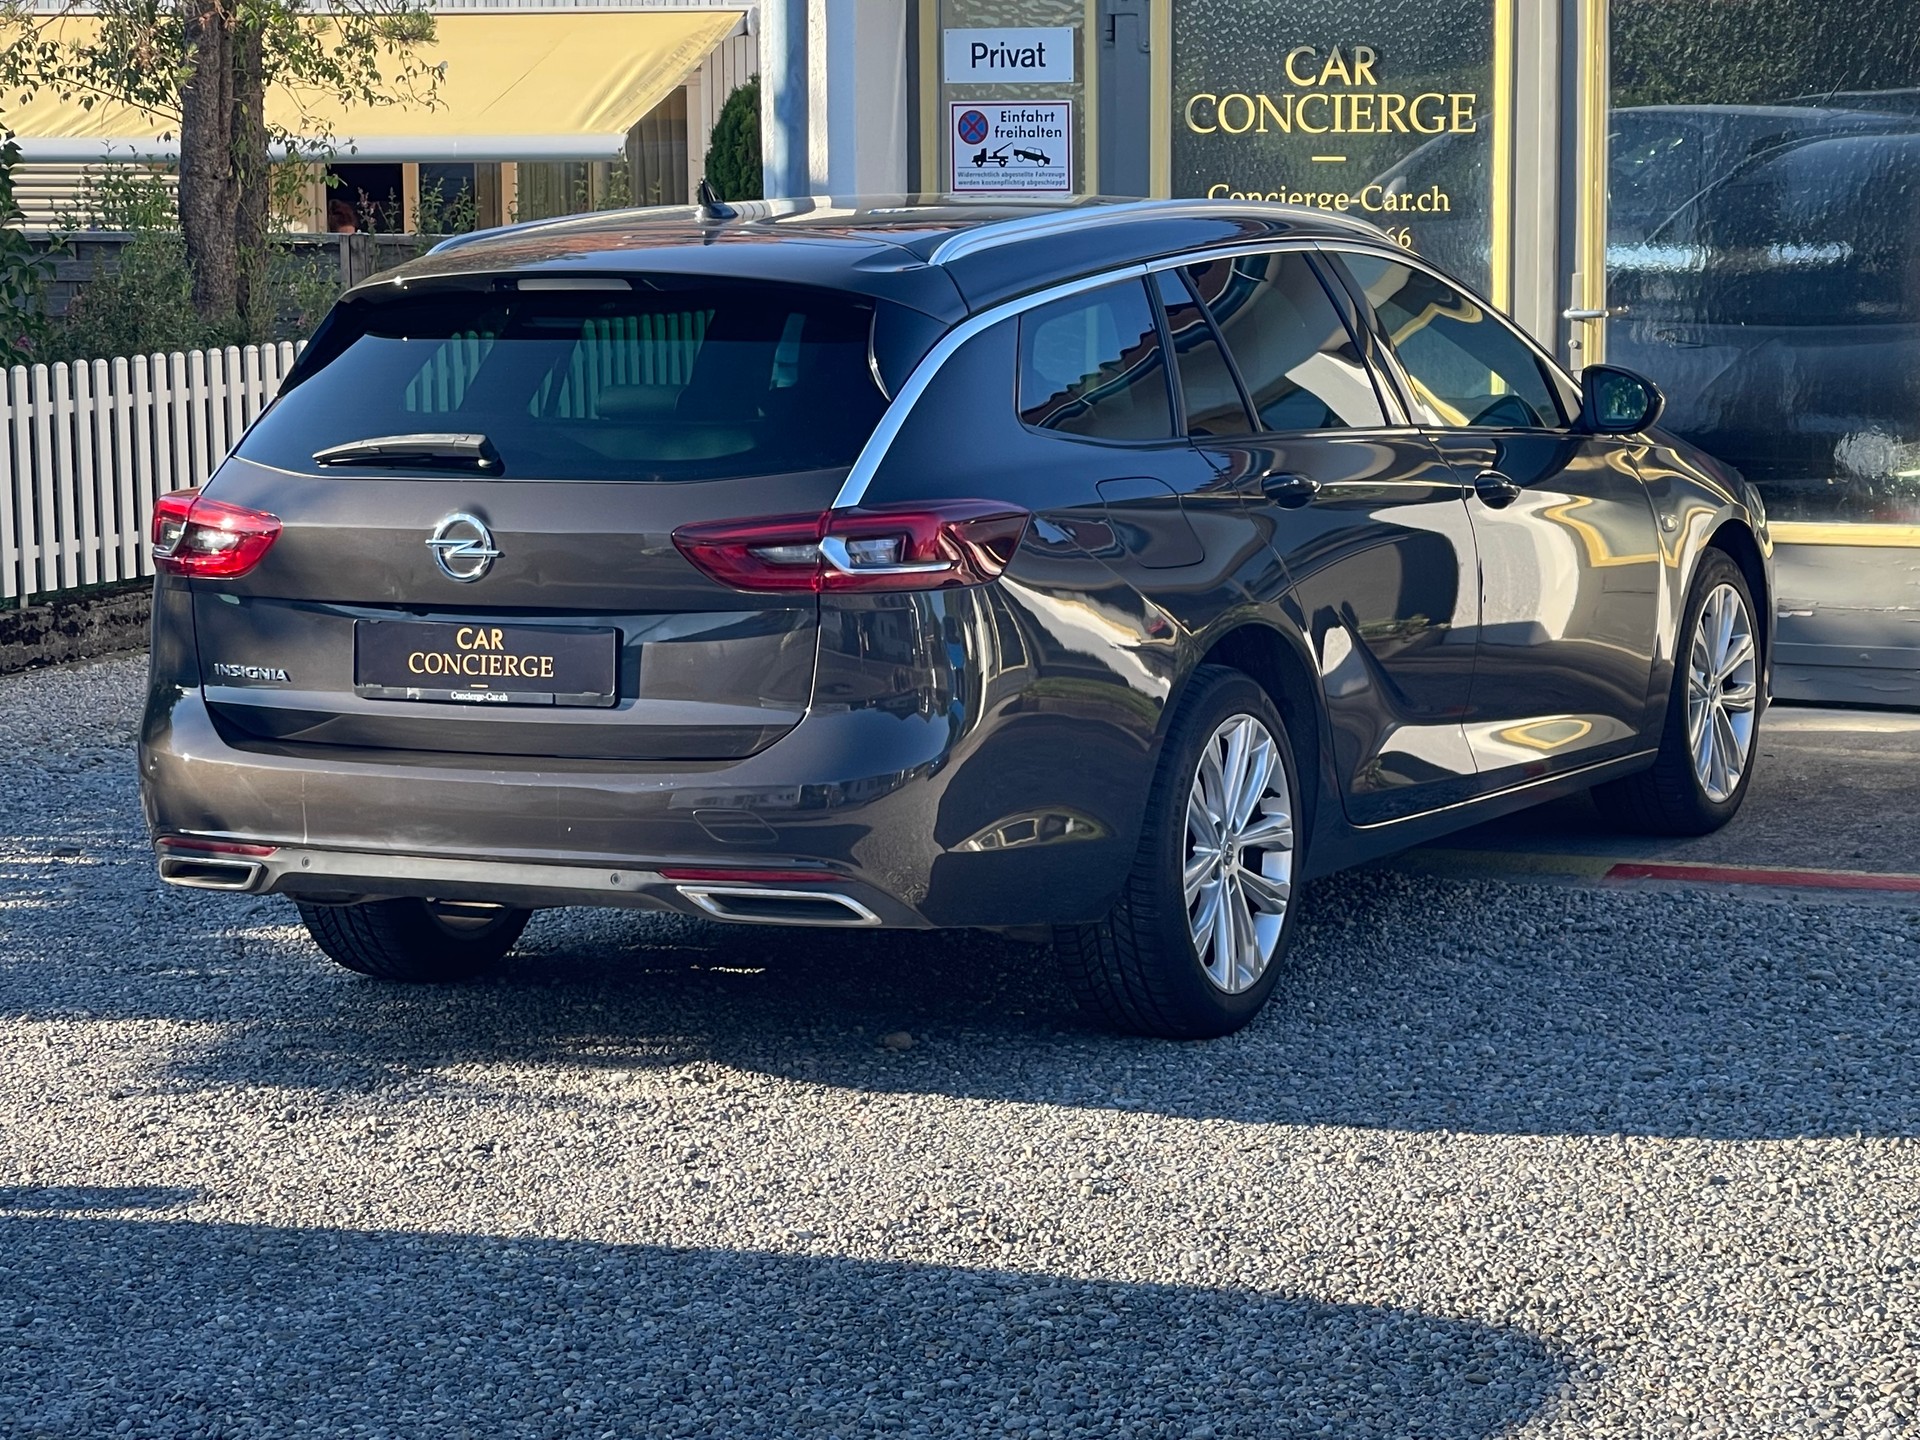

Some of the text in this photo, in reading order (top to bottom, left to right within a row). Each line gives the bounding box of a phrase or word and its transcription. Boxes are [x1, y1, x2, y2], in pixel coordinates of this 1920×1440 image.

[971, 42, 1046, 68] Privat
[1285, 45, 1378, 87] CAR
[1000, 110, 1055, 123] Einfahrt
[1184, 93, 1477, 134] CONCIERGE
[994, 126, 1062, 138] freihalten
[456, 627, 504, 651] CAR
[213, 663, 291, 682] INSIGNIA
[408, 652, 554, 678] CONCIERGE
